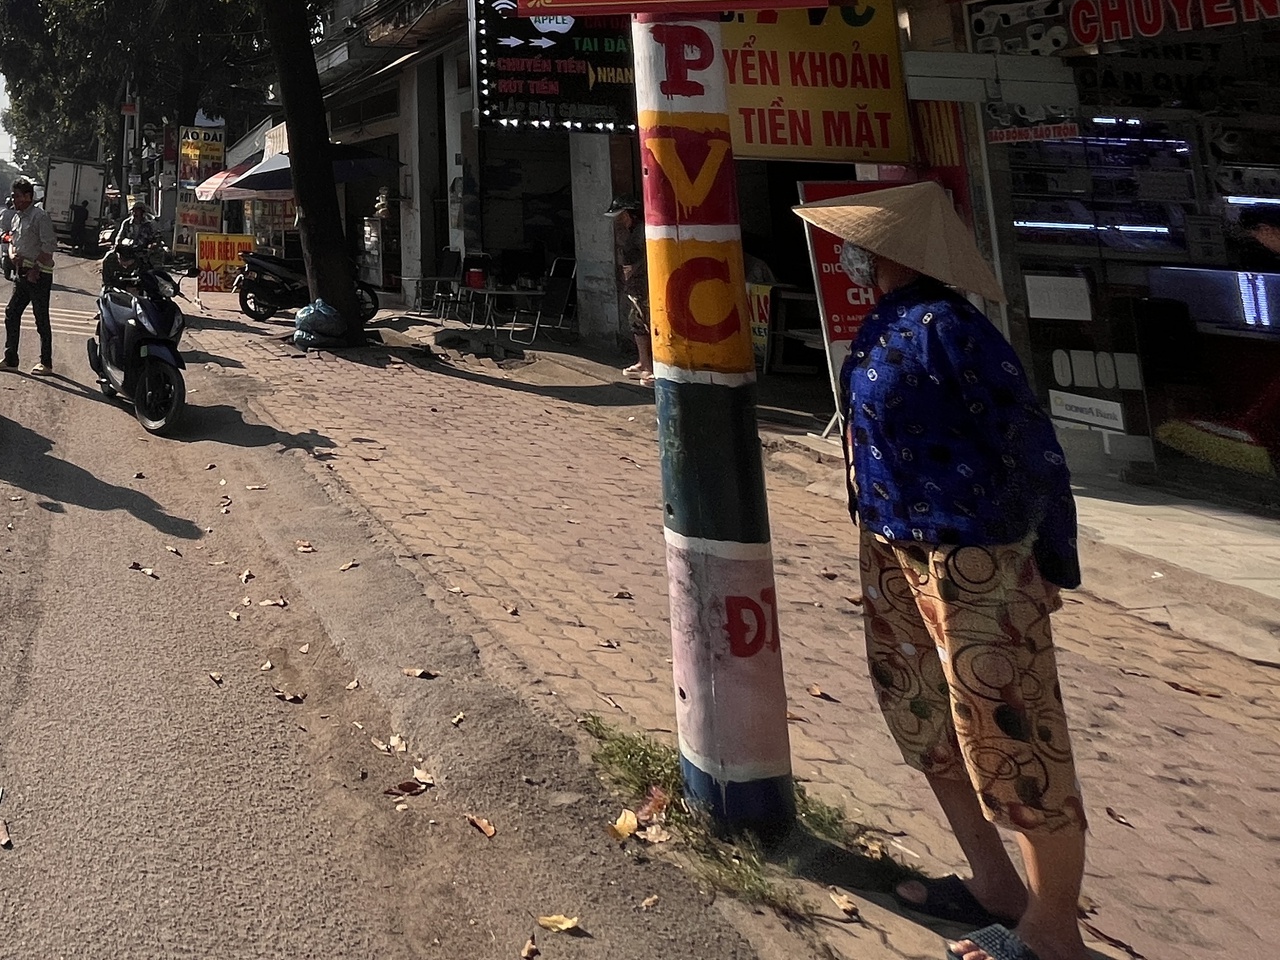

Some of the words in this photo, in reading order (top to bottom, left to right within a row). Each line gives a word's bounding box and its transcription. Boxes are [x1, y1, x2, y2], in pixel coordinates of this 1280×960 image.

[533, 15, 569, 25] APPLE
[604, 34, 631, 53] ĐÂ
[788, 39, 891, 90] KHOẢN
[596, 66, 634, 84] NHAN
[738, 96, 813, 147] TIỀN
[822, 103, 891, 157] MẶT
